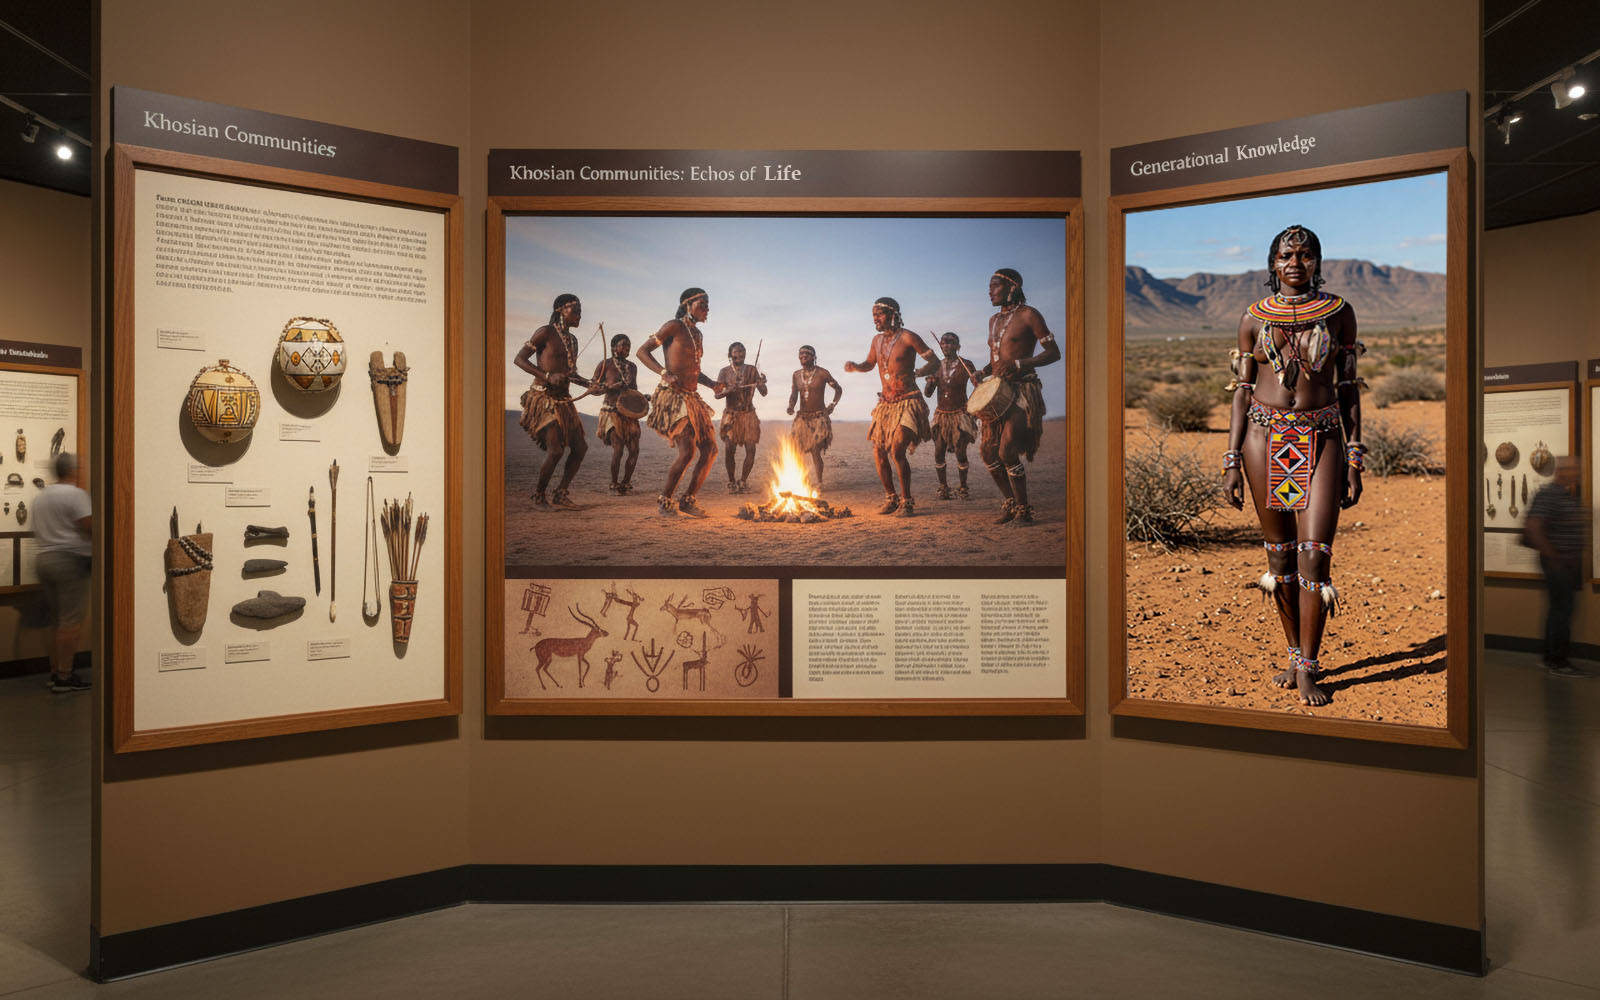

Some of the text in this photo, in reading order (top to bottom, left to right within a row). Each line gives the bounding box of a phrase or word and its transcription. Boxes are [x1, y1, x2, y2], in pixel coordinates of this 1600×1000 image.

[144, 111, 337, 158] Khosian Communities
[1130, 134, 1316, 176] Generational Knowledge
[509, 164, 801, 181] Khosian Communities: Echos of Life
